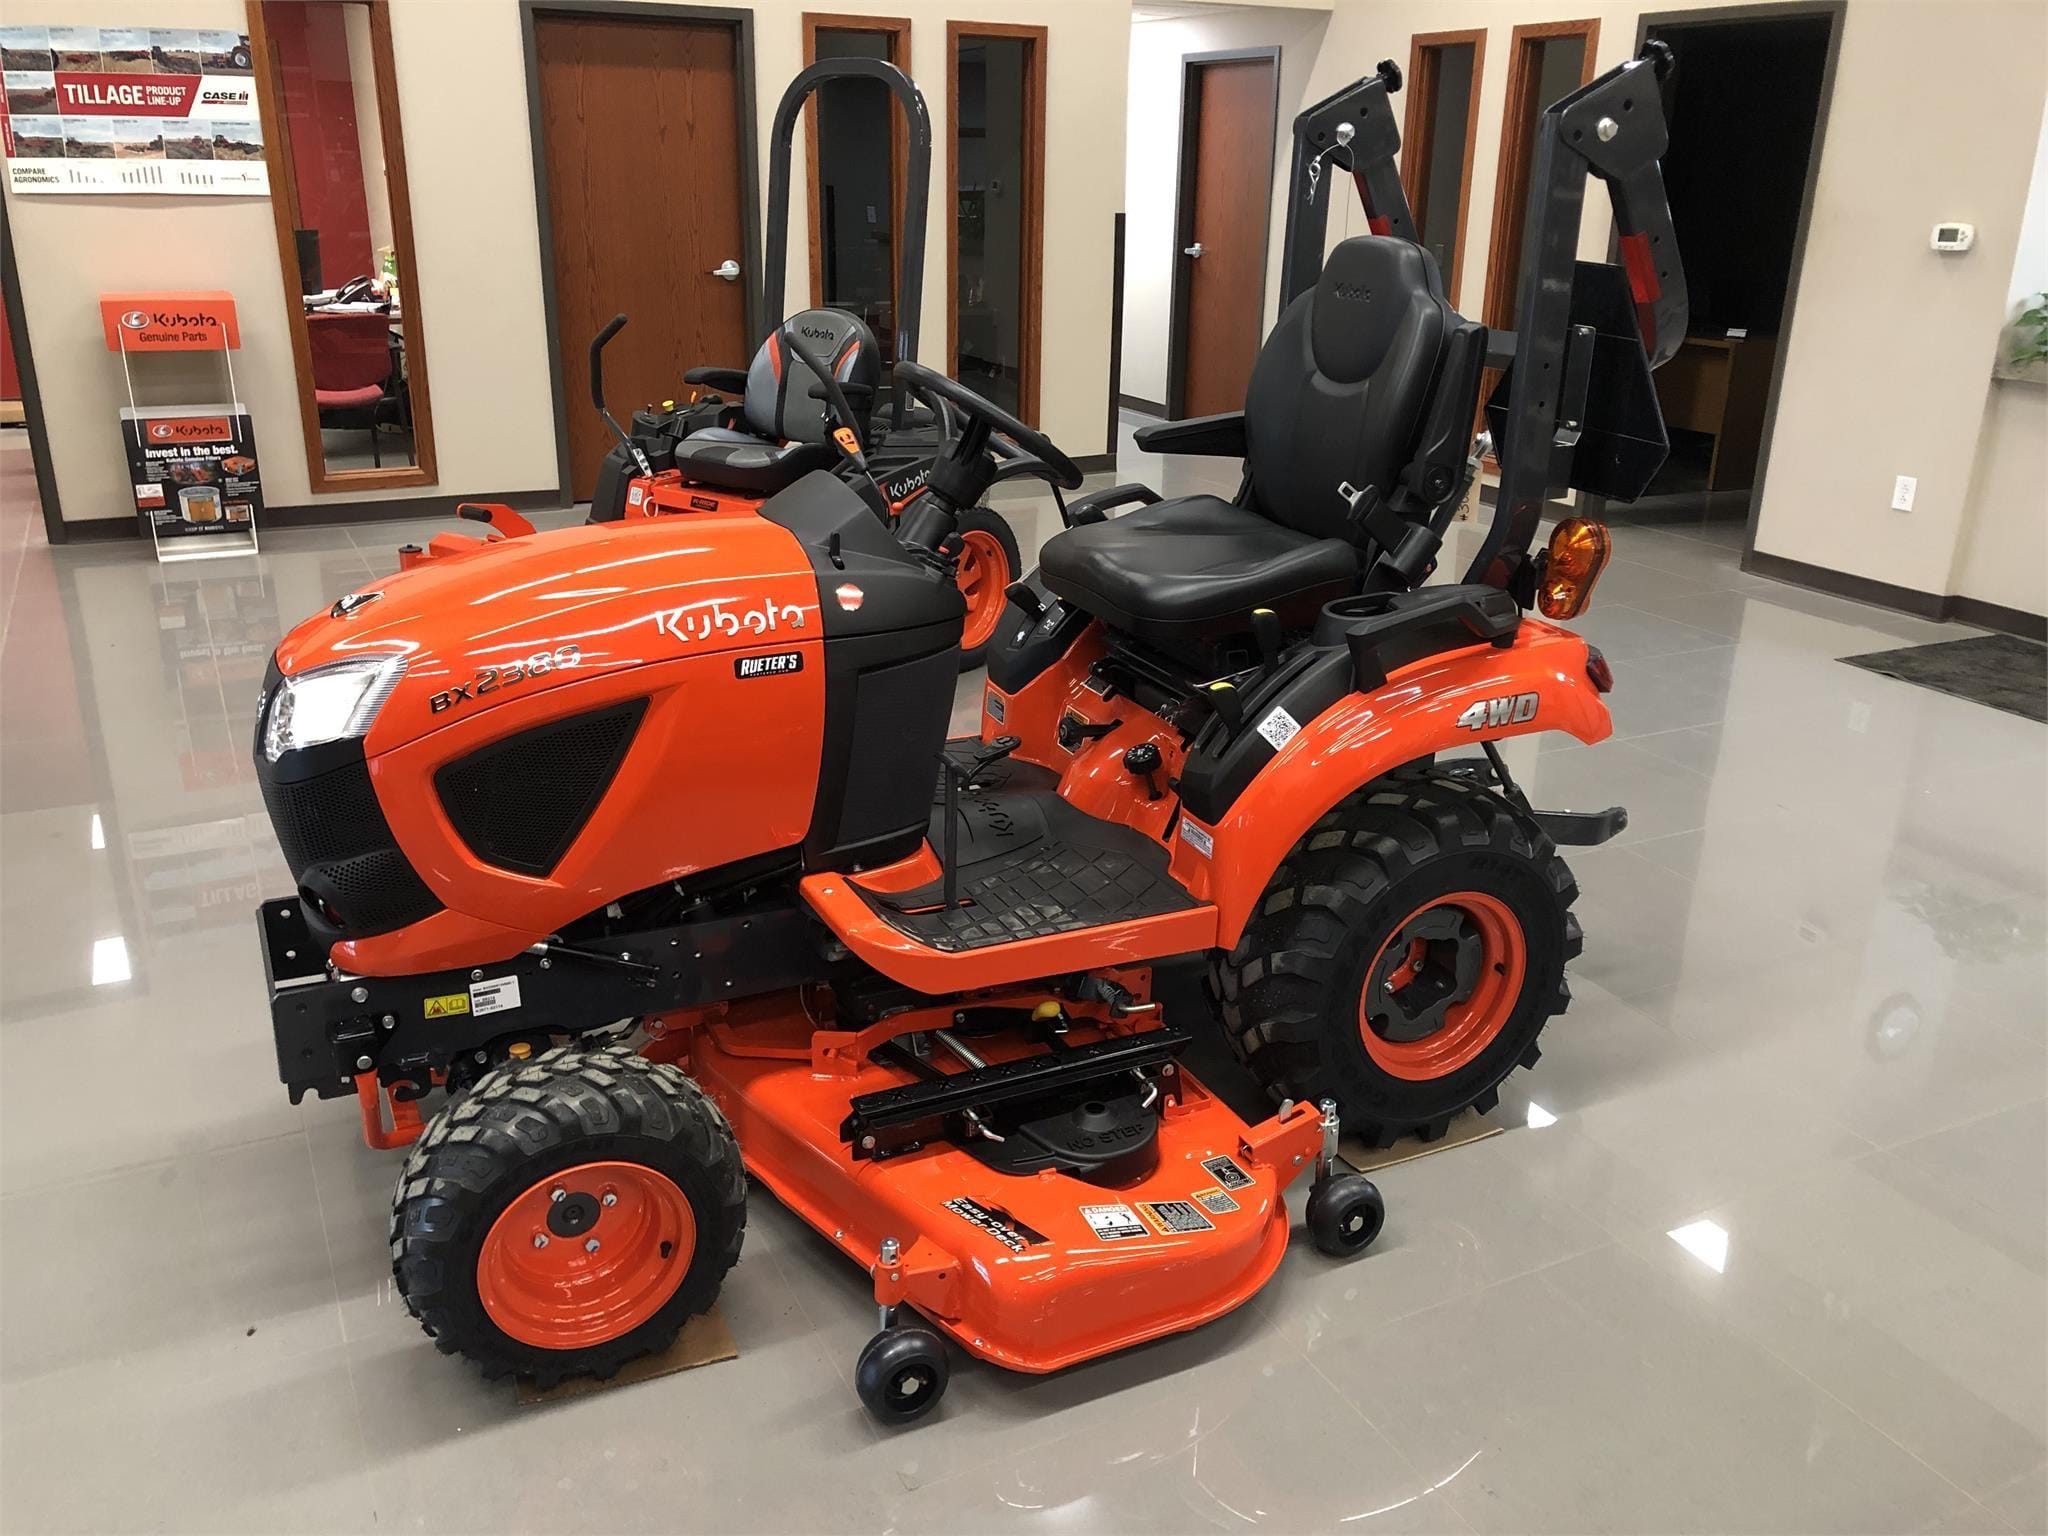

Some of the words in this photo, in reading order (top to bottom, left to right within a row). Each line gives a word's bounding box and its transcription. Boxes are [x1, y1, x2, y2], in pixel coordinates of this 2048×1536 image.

[62, 84, 146, 105] TILLAGE
[145, 85, 187, 96] PRODUCT
[202, 91, 237, 101] CASE
[146, 96, 182, 106] LINE-UP
[12, 167, 46, 175] COMPARE
[13, 176, 60, 184] AGRONOMICS
[152, 312, 218, 327] Kubota
[139, 332, 180, 343] Genuine
[182, 331, 208, 342] Parts
[801, 325, 834, 341] Kubota
[175, 424, 224, 436] Kubota
[144, 447, 179, 459] Invest
[192, 445, 211, 456] the
[212, 444, 239, 455] best.
[654, 597, 806, 643] Kubota
[740, 654, 798, 676] RUETER'S
[1456, 691, 1540, 731] 4WD
[1065, 1136, 1096, 1151] NO
[1098, 1123, 1146, 1144] STEP
[941, 1200, 988, 1228] Mower
[985, 1227, 1024, 1253] Deck
